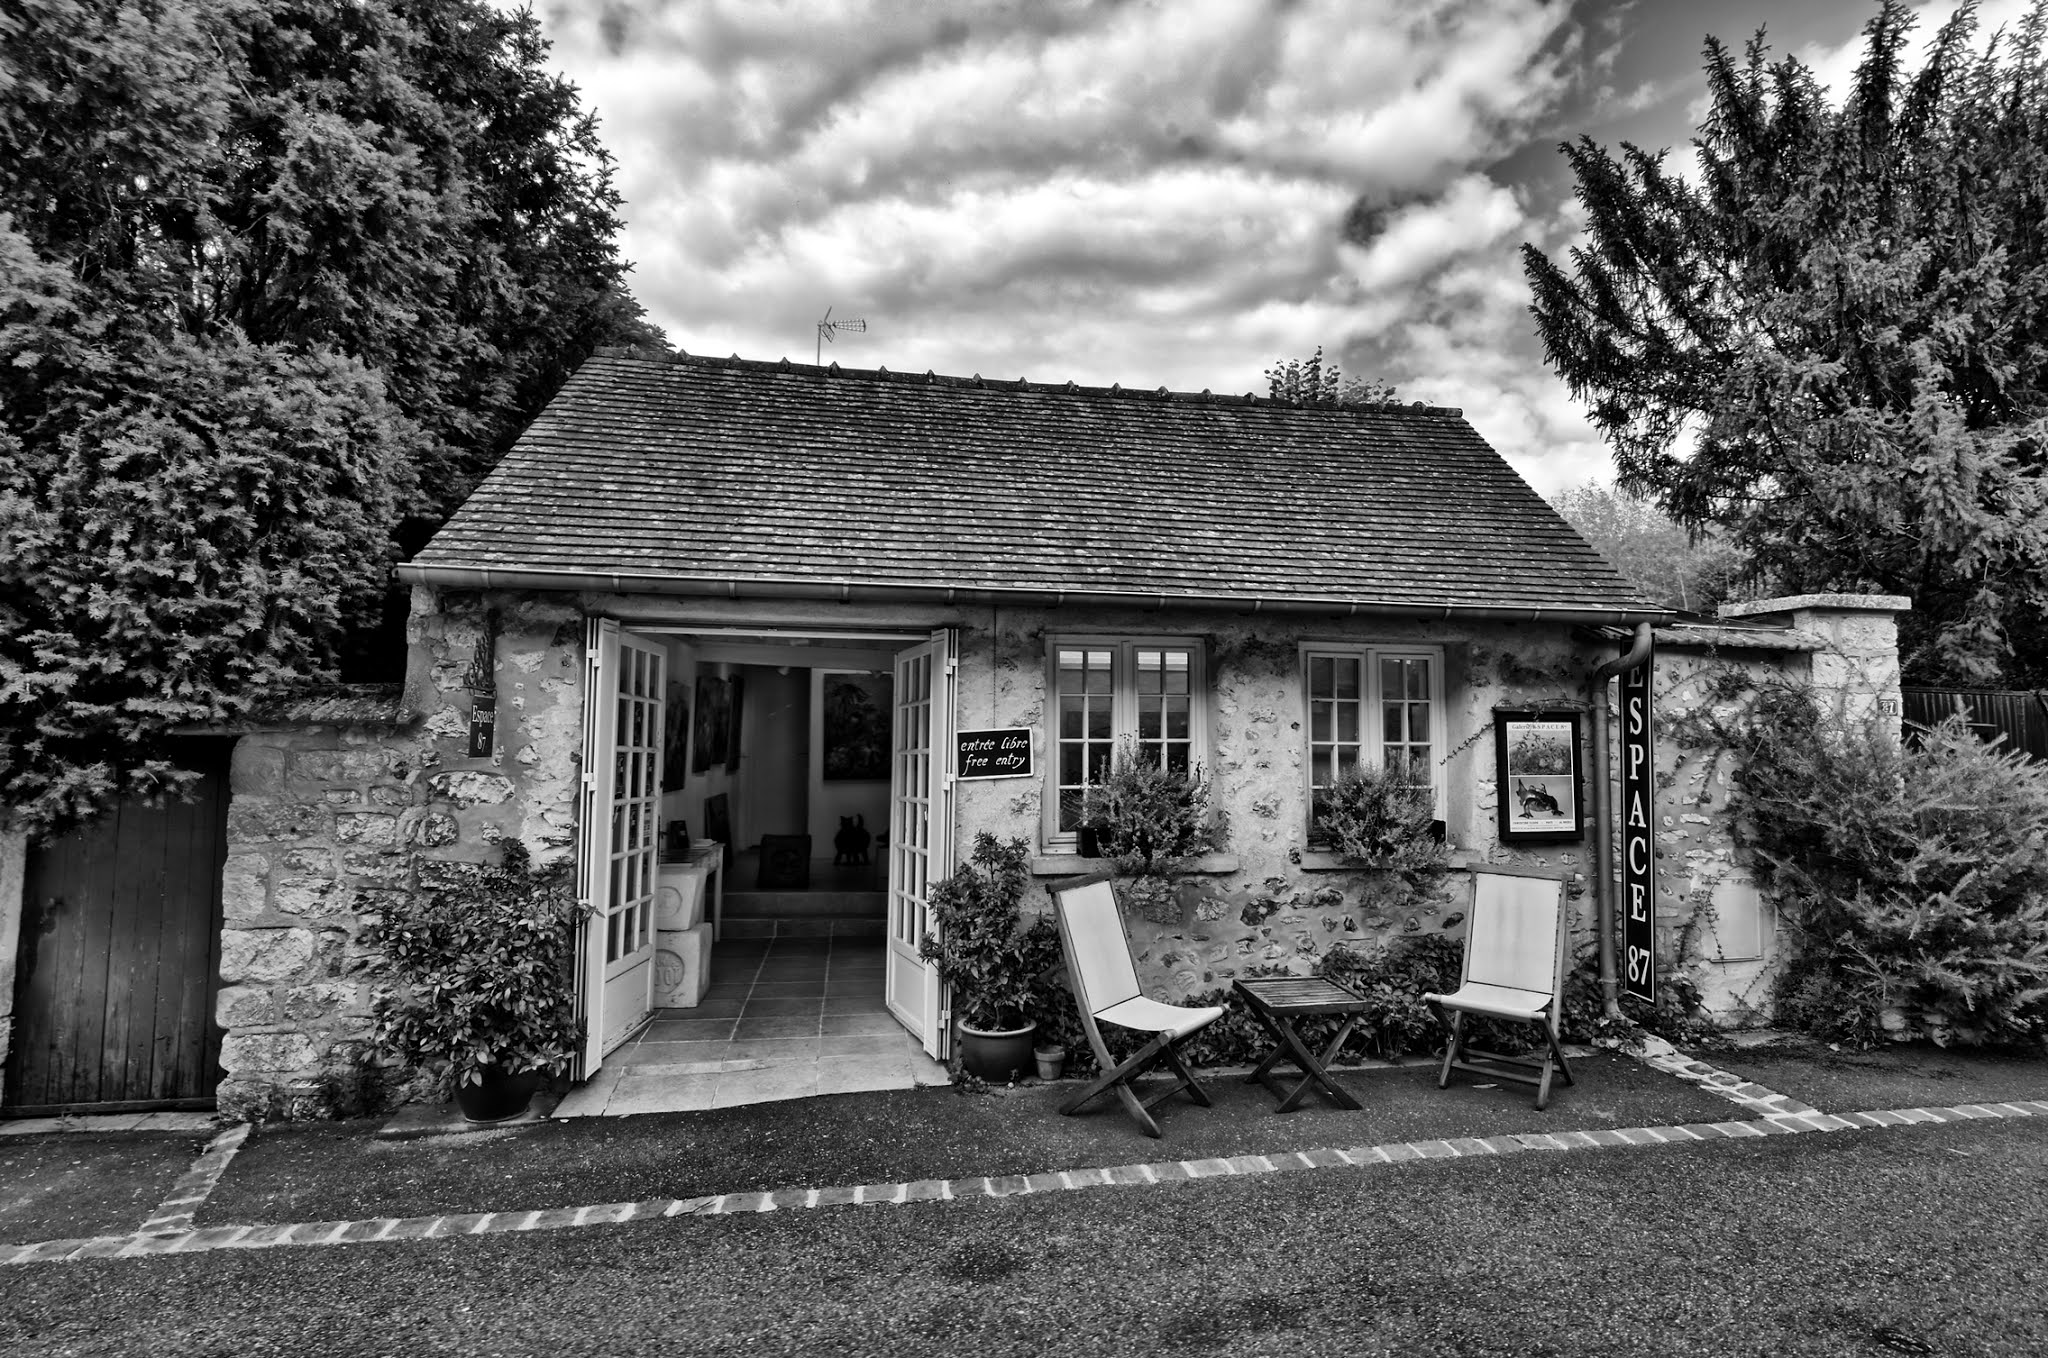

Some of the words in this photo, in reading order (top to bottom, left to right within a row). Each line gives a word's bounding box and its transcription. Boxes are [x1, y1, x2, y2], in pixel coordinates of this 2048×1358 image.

[472, 704, 494, 728] Espace
[477, 732, 487, 753] 87
[961, 738, 996, 752] entrée
[1000, 736, 1028, 750] libre
[962, 754, 989, 776] free
[995, 752, 1026, 770] entry
[1628, 666, 1647, 923] ESPACE
[1628, 945, 1650, 986] 87
